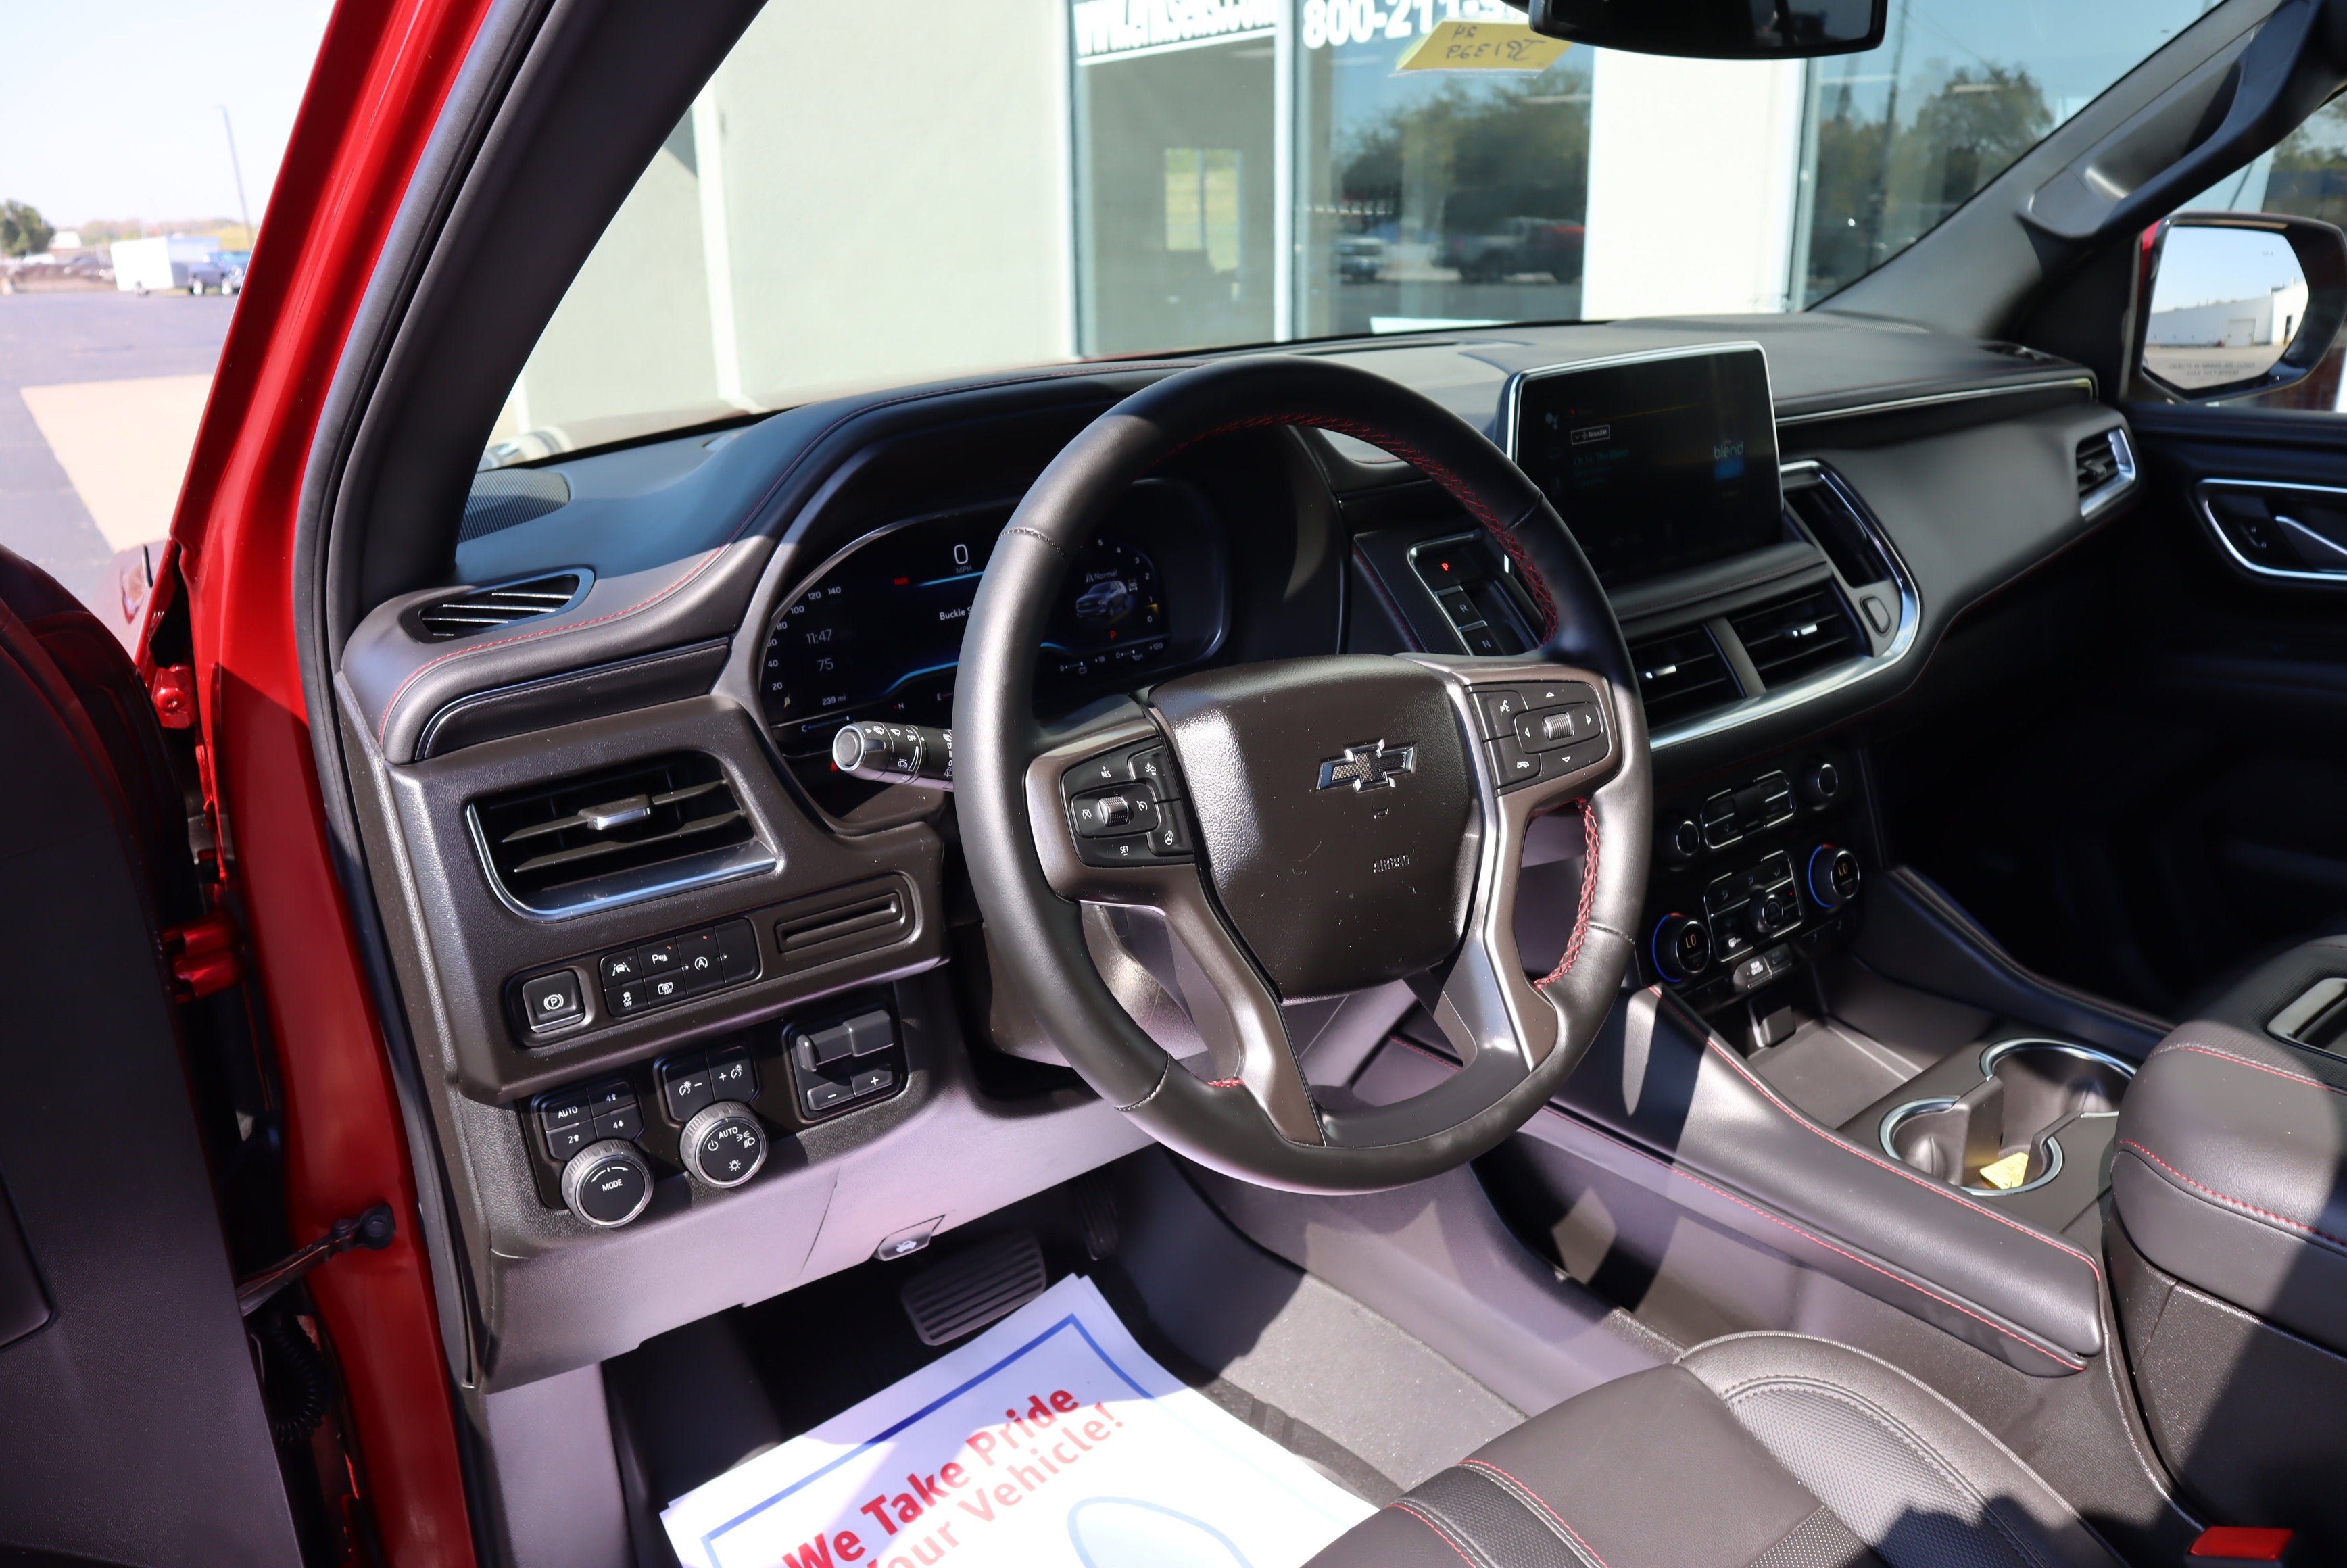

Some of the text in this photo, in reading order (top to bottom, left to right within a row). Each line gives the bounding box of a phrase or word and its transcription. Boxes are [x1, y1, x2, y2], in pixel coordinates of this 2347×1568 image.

[954, 544, 969, 564] 0
[956, 565, 972, 574] MPH
[1441, 562, 1449, 572] P
[1094, 569, 1118, 579] Normal
[808, 591, 821, 600] 120
[827, 587, 842, 595] 140
[790, 606, 804, 614] 100
[939, 608, 966, 620] Buckle
[1459, 604, 1469, 613] R
[777, 622, 788, 630] 80
[806, 629, 832, 645] 11:47
[1110, 631, 1117, 640] P
[1482, 639, 1491, 649] N
[768, 660, 778, 668] 40
[817, 658, 833, 672] 75
[772, 682, 783, 691] 20
[822, 693, 846, 706] 239 mi
[1120, 845, 1129, 854] SET
[1373, 854, 1410, 873] AIRBAG
[1837, 862, 1849, 877] LO
[1685, 933, 1697, 949] LO
[558, 1106, 578, 1119] AUTO
[719, 1127, 738, 1140] AUTO
[602, 1178, 623, 1192] MODE
[781, 1389, 1079, 1568] We Take Pride
[867, 1401, 1124, 1568] our Vehicle!
